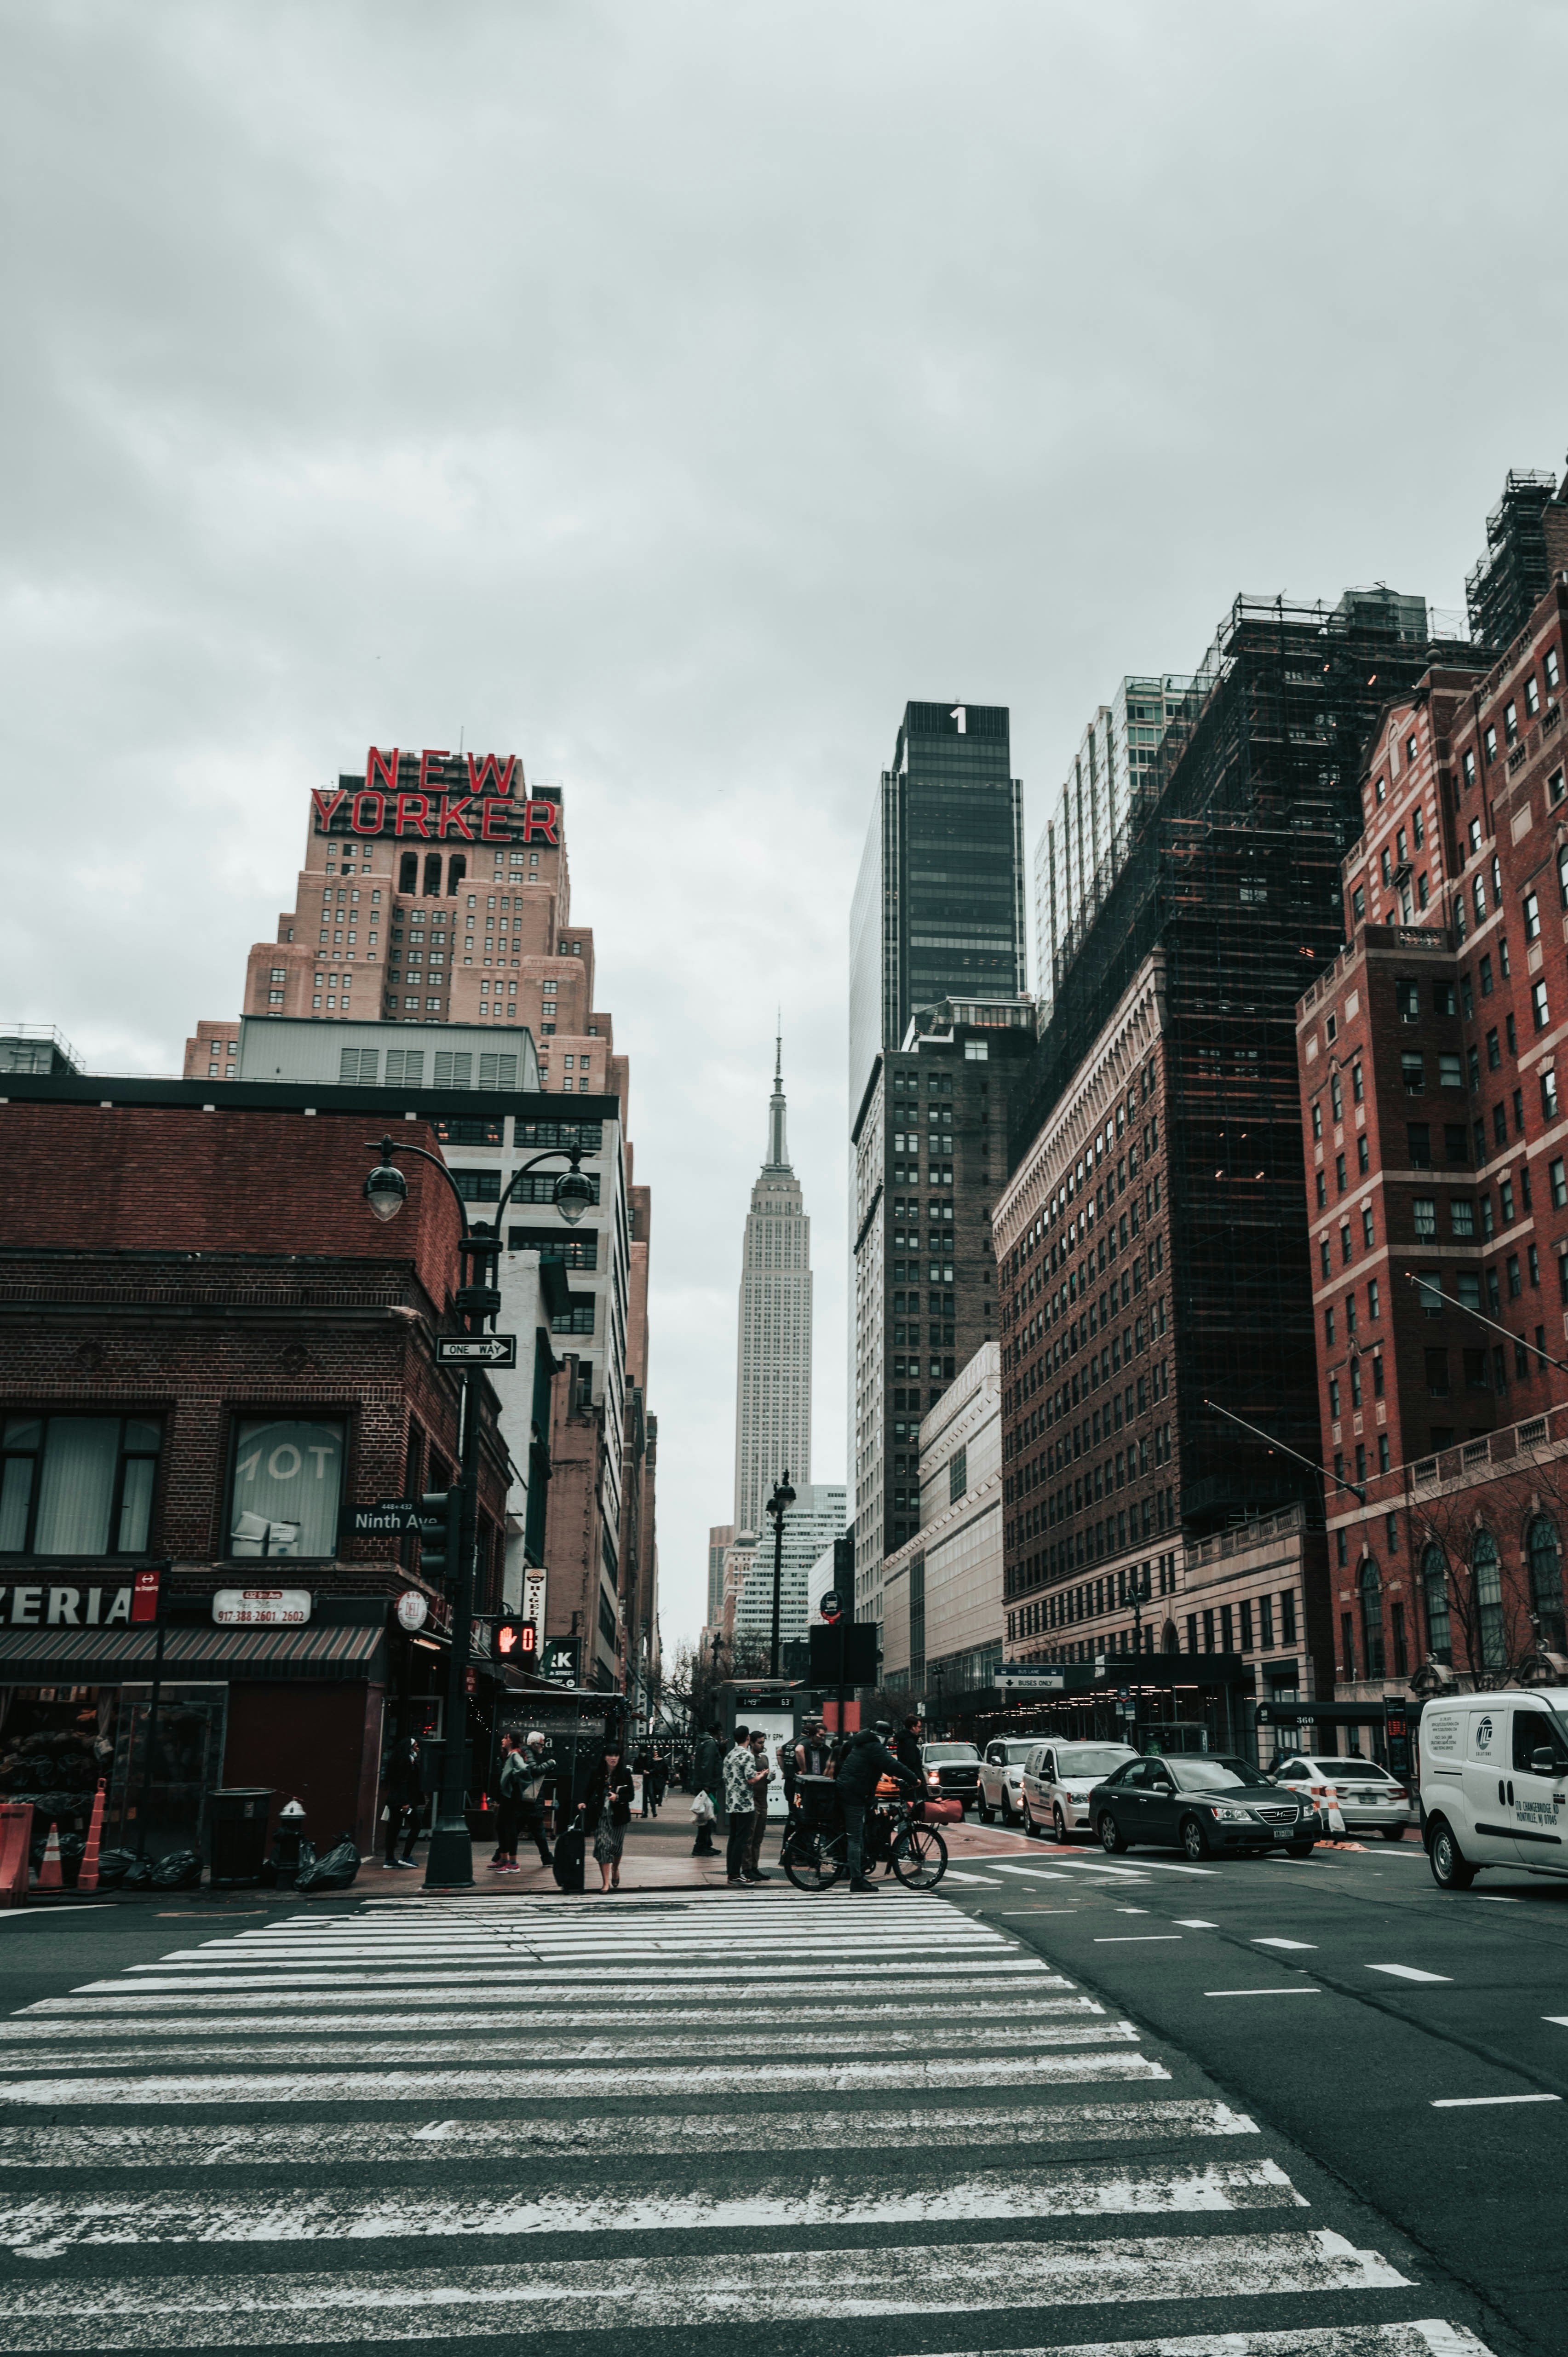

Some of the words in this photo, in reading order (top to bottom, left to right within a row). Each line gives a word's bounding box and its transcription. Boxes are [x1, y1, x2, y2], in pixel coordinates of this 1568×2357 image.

[949, 707, 967, 734] 1
[365, 746, 516, 795] NEW
[310, 788, 558, 844] YORKER
[449, 1345, 470, 1354] ONE
[479, 1345, 501, 1354] WAY
[356, 1513, 400, 1528] Ninth
[0, 1587, 132, 1624] ERIA
[522, 1628, 533, 1651] 0
[1523, 1801, 1551, 1813] CHANGEBRIDGE
[1553, 1804, 1559, 1814] RD
[1538, 1814, 1543, 1826] NJ
[1545, 1815, 1557, 1825] 07045
